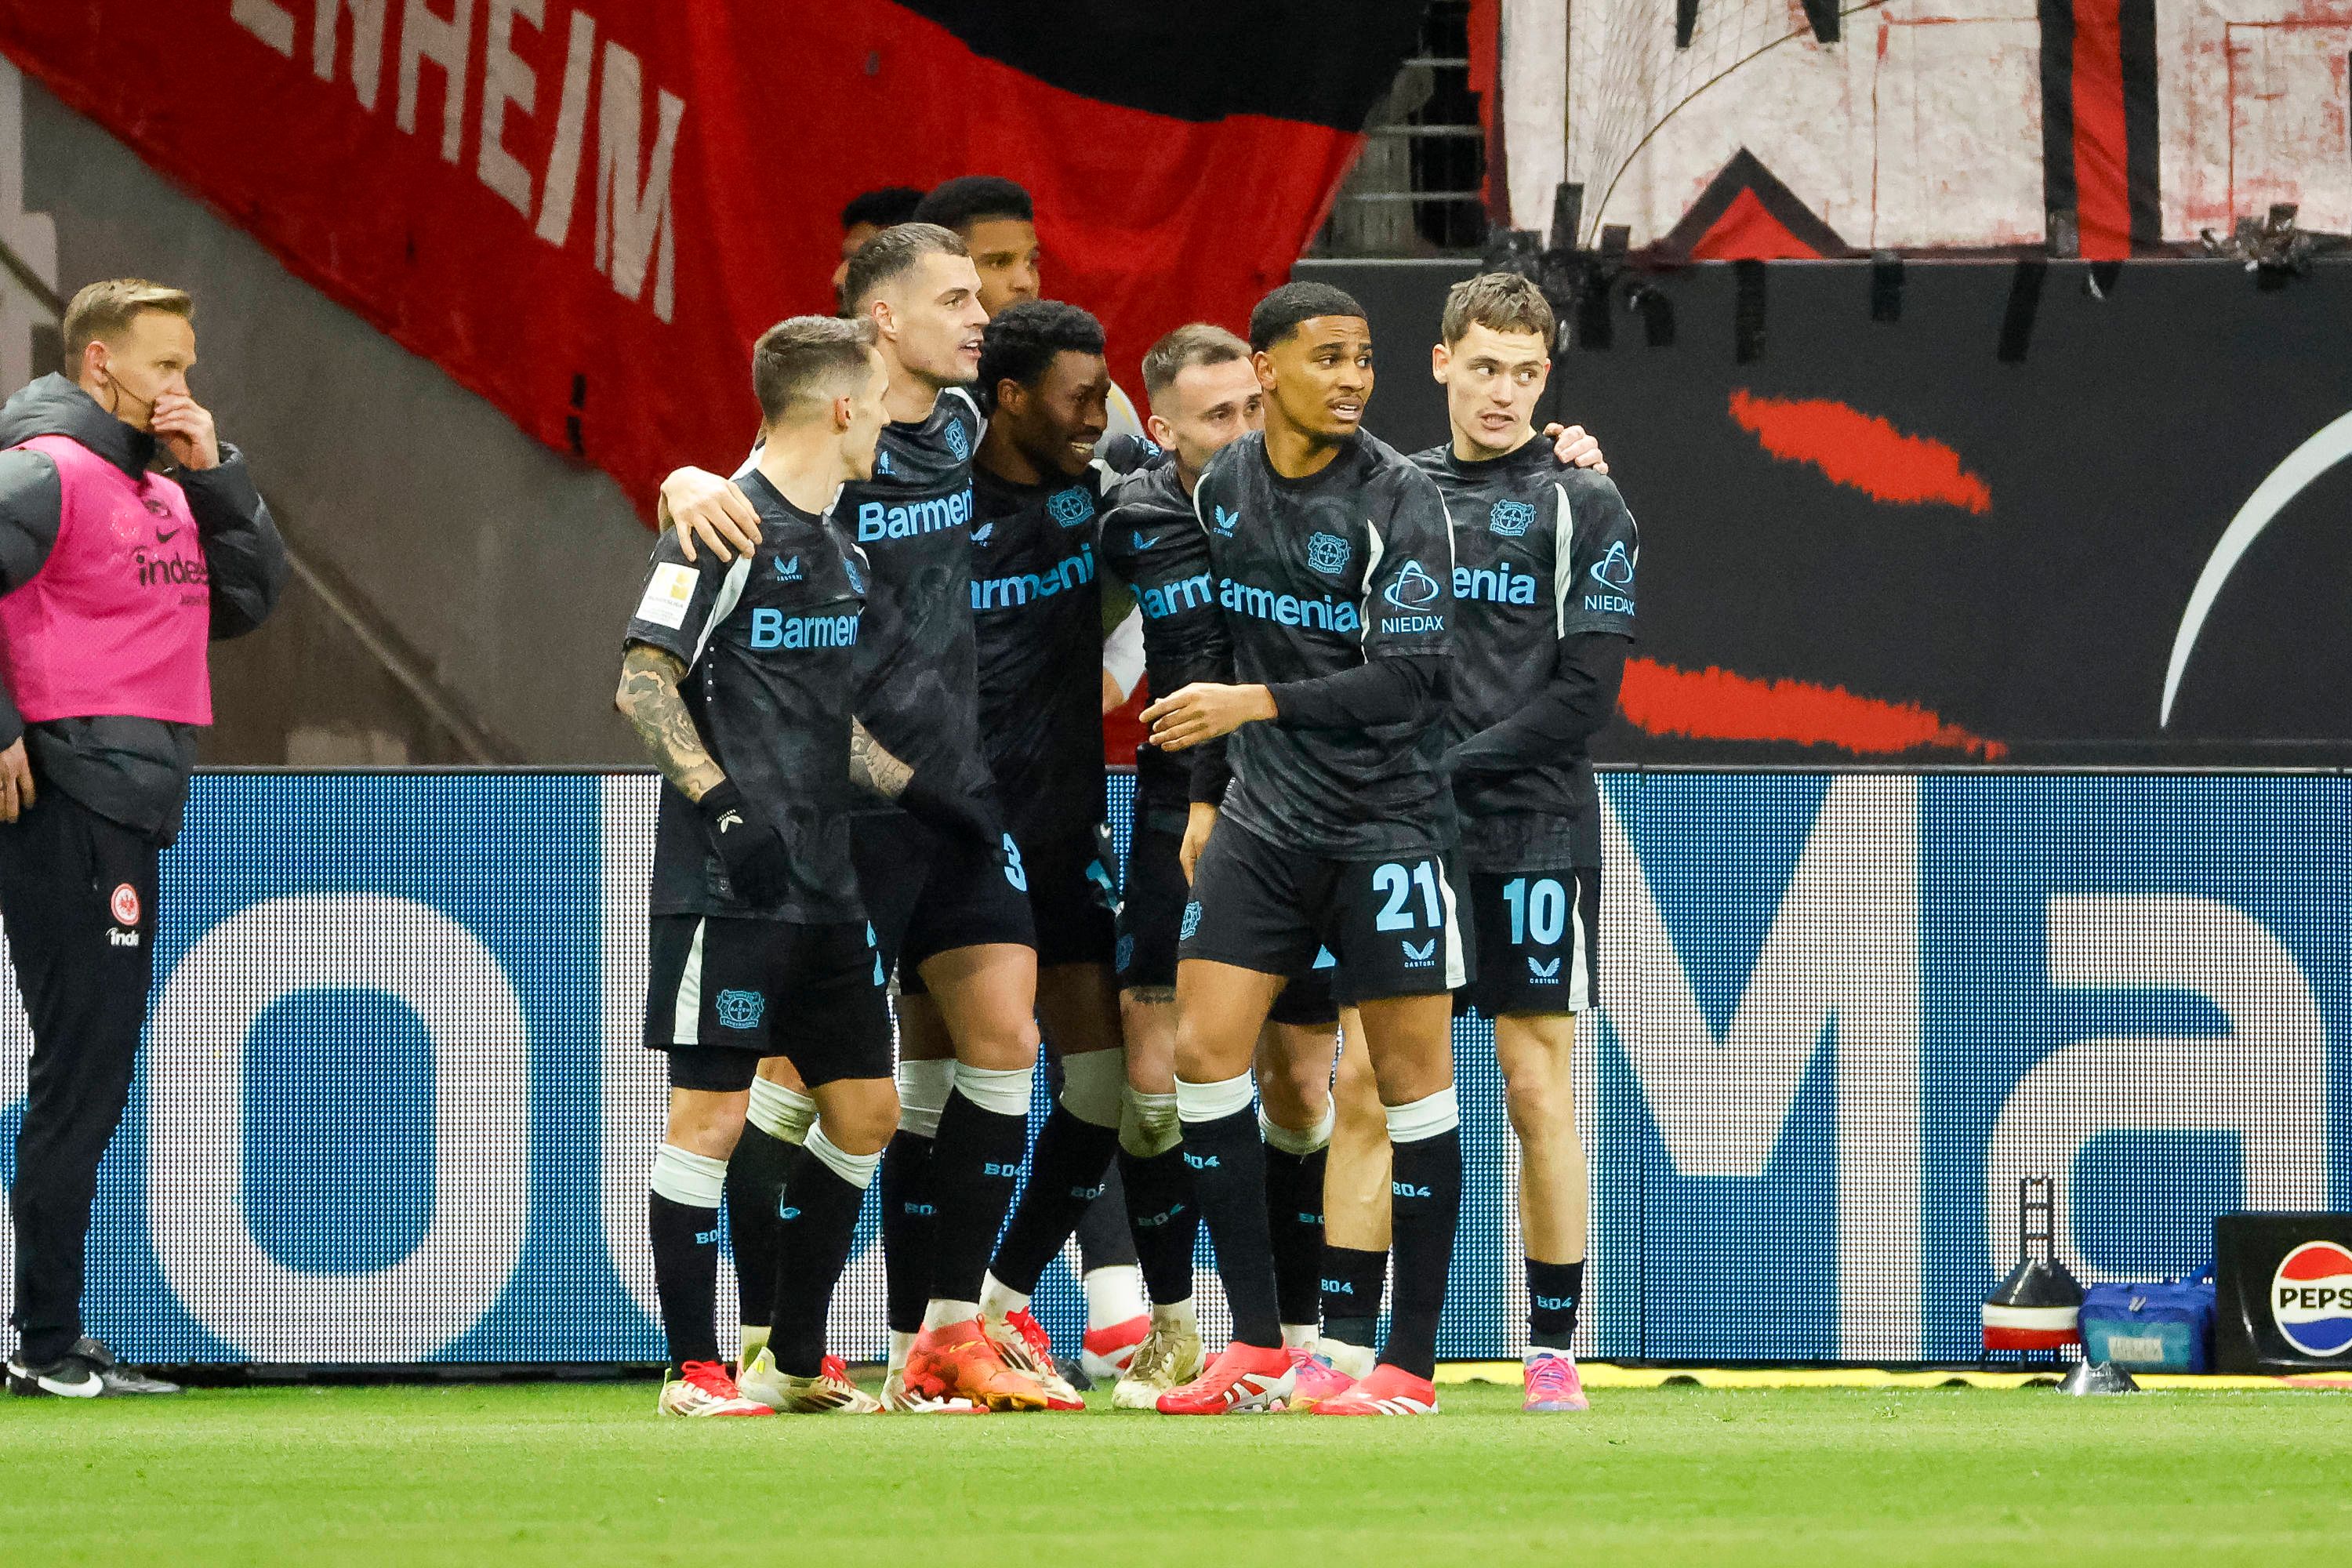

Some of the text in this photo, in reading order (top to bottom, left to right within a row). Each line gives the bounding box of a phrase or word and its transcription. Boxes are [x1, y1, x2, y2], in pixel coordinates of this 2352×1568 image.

[1584, 594, 1635, 616] NIEDAX
[1381, 615, 1444, 633] NIEDAX
[1373, 861, 1441, 931] 21
[1503, 878, 1566, 945] 10
[1184, 1152, 1221, 1169] B04
[1392, 1181, 1431, 1196] B04
[1321, 1279, 1354, 1294] B04
[1537, 1295, 1572, 1310] B04
[2280, 1288, 2352, 1309] PEPS
